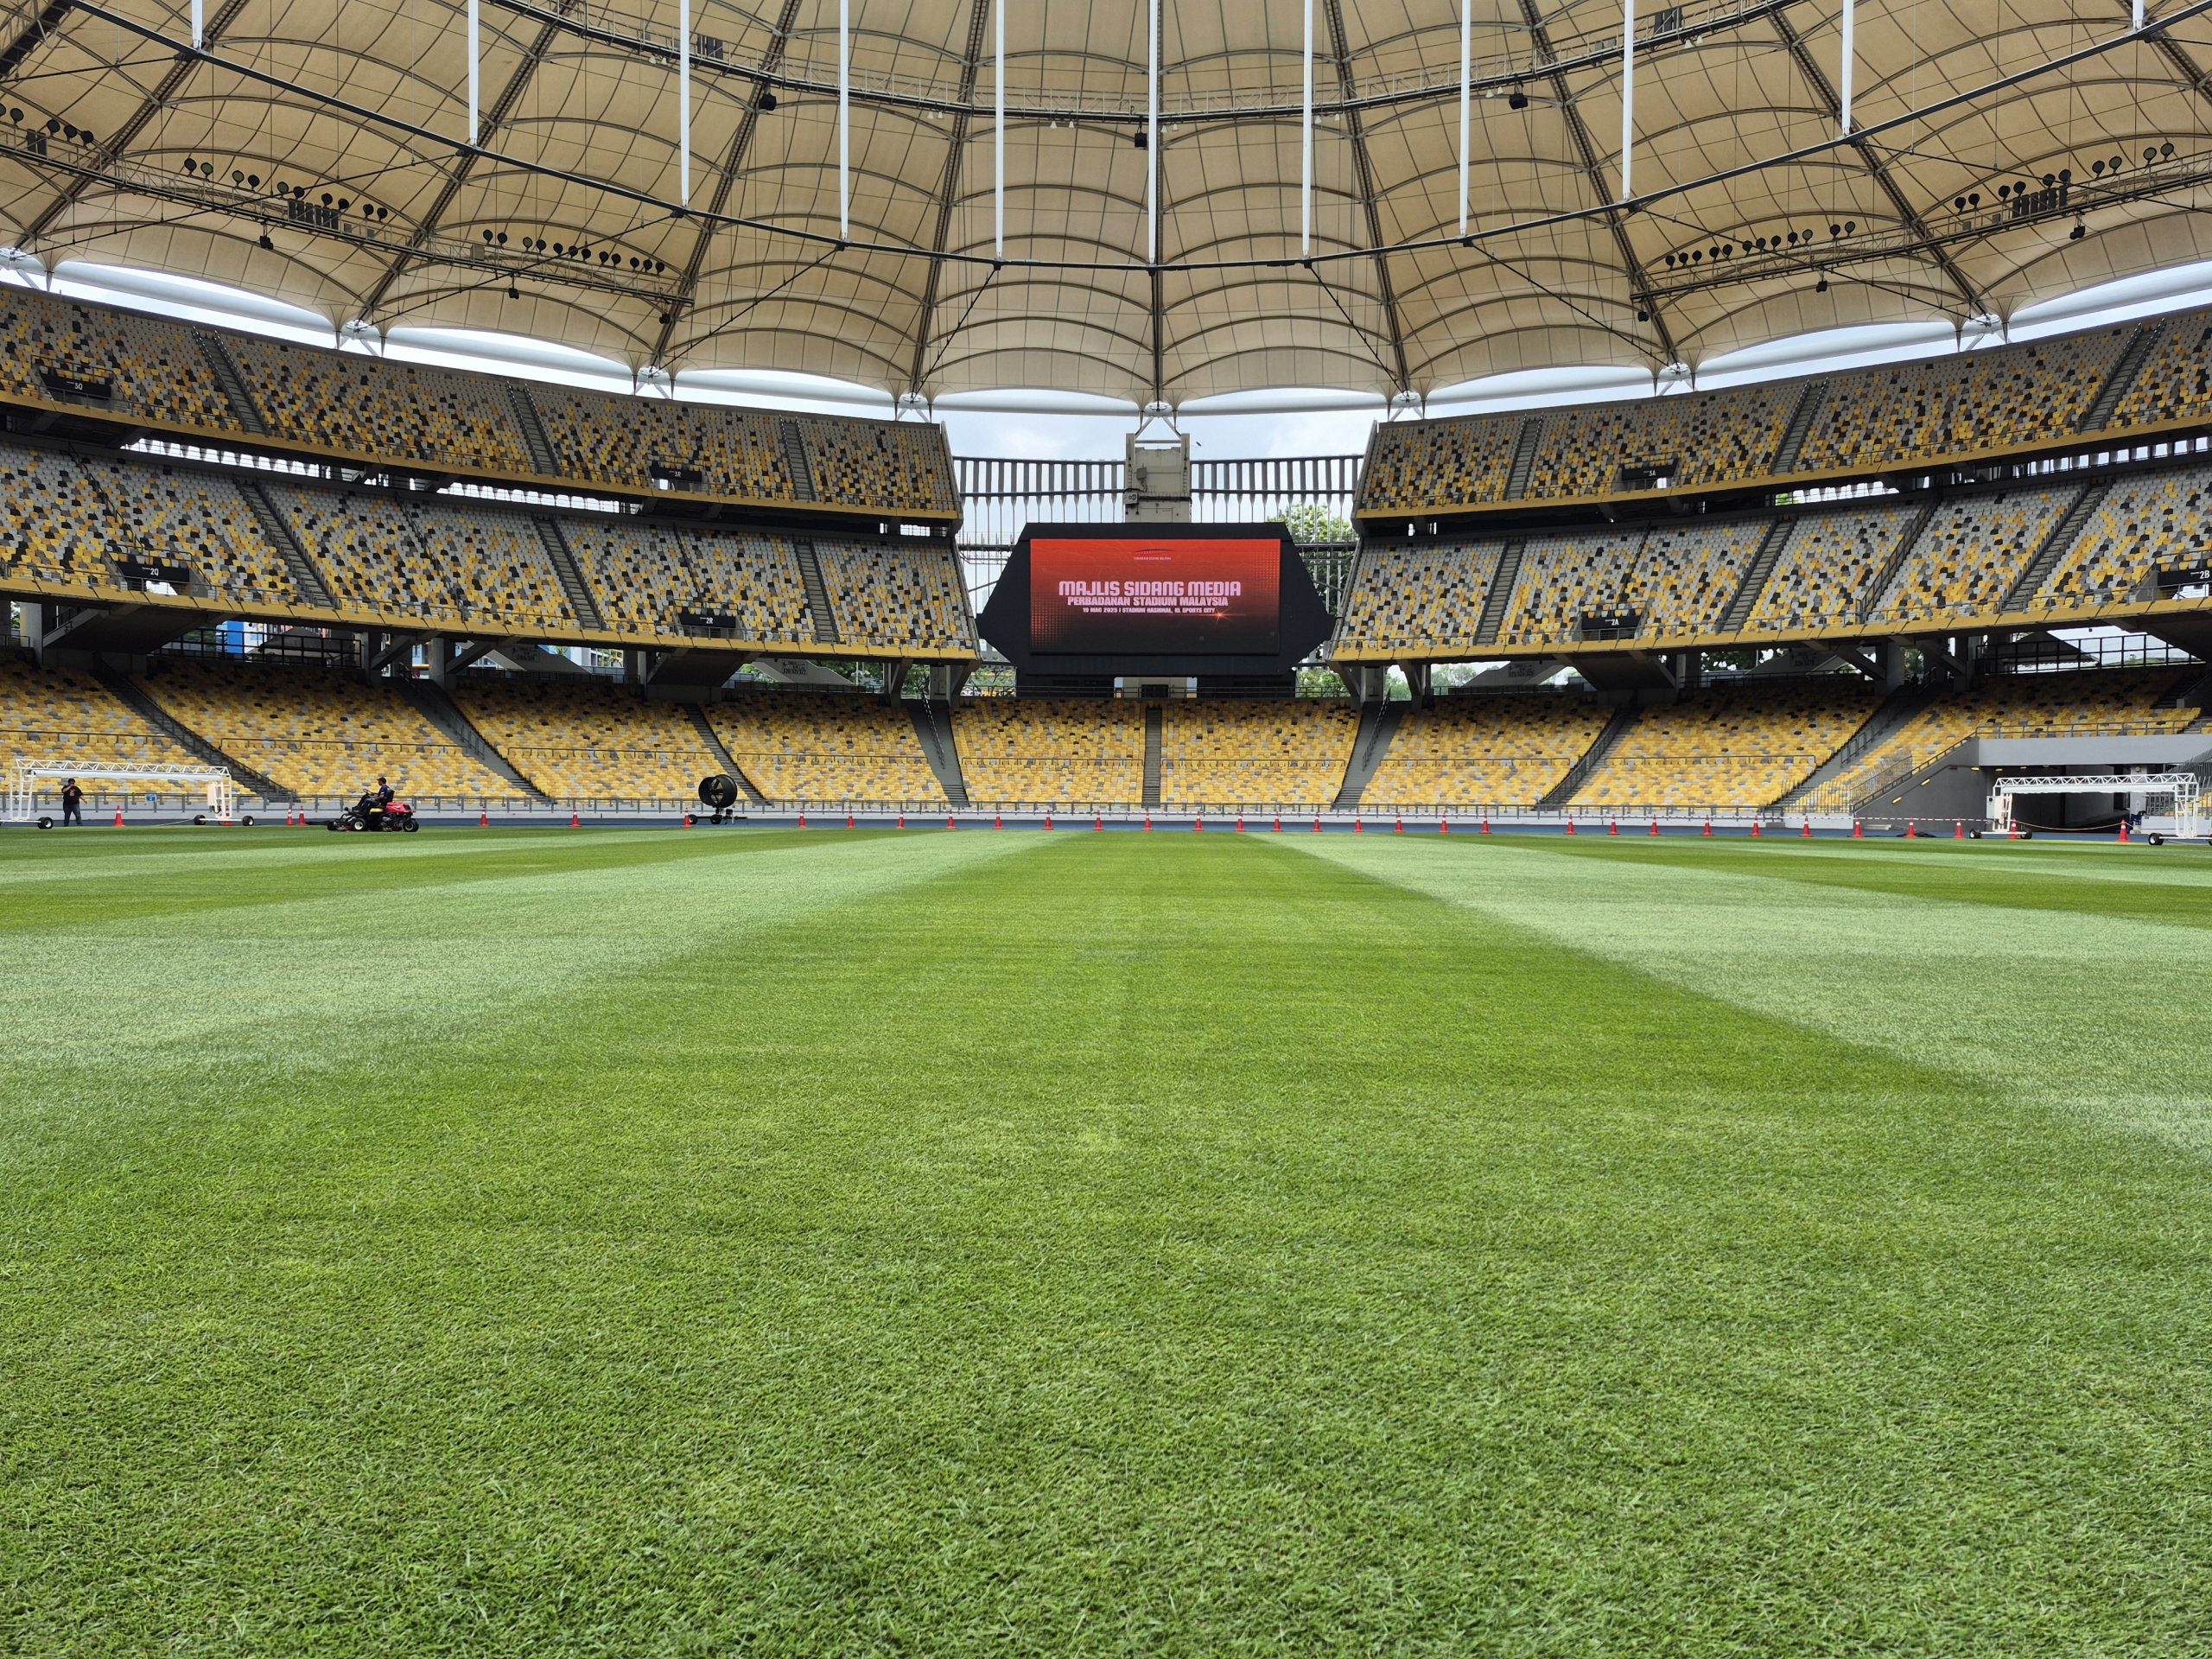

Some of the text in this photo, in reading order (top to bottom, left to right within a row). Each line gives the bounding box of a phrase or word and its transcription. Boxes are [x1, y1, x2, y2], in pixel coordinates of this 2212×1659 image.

[2199, 570, 2210, 579] 2B
[1058, 581, 1242, 596] MAJLIS SIDANG MEDIA
[1067, 596, 1229, 606] PERBADANAN STADIUM MALAYSIA
